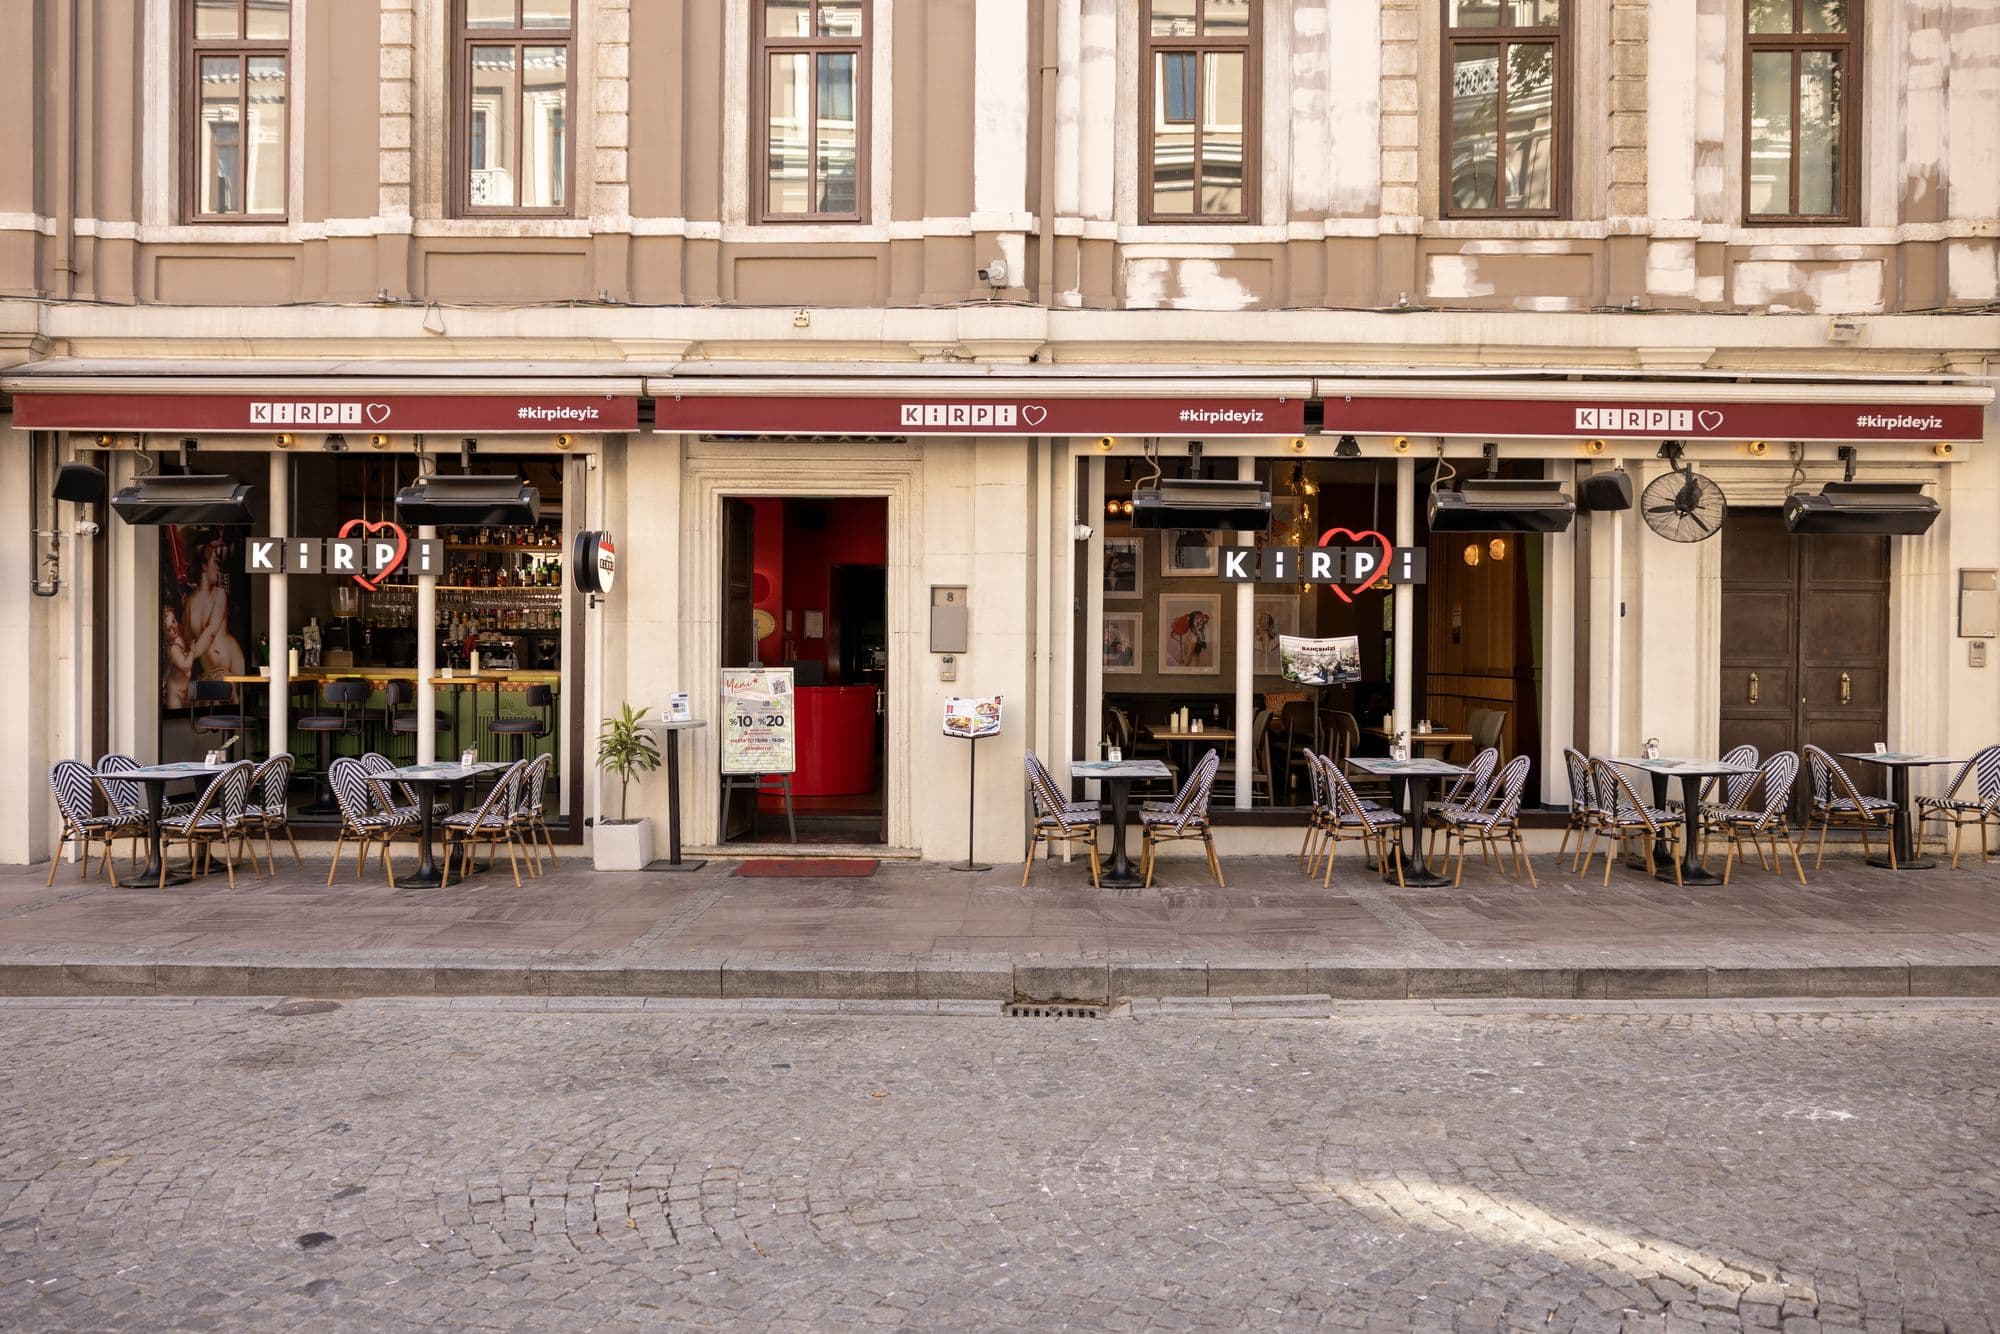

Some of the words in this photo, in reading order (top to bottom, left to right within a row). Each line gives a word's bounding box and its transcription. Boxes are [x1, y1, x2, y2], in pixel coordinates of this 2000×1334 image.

[517, 406, 599, 421] #kirpideyiz
[1179, 408, 1264, 424] #kirpideyiz
[1856, 414, 1943, 430] #kirpideyiz
[947, 592, 954, 602] 8
[726, 678, 752, 694] Yeni
[729, 715, 753, 727] %10
[757, 715, 784, 727] %20
